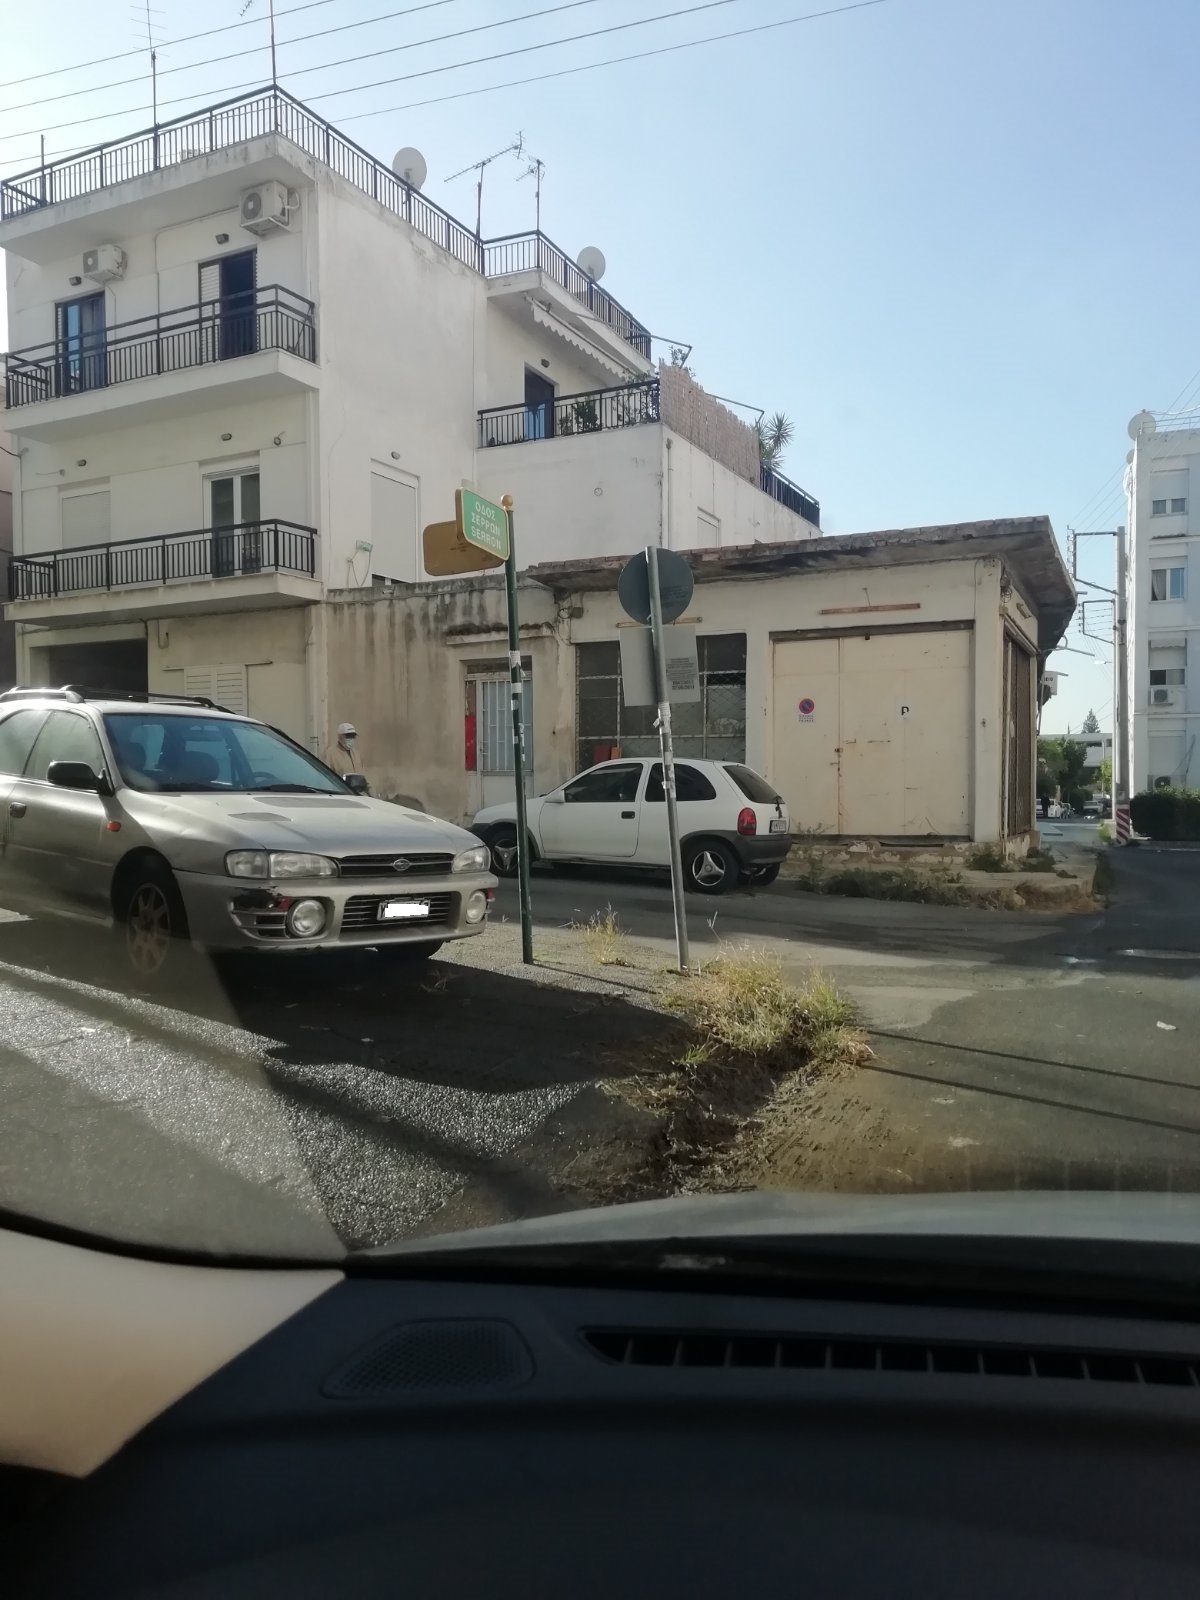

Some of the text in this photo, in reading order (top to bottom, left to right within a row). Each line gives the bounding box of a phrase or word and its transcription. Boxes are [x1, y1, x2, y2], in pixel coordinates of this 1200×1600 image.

[475, 501, 496, 521] ΟΔΟΣ
[471, 512, 501, 536] ΣΕΡΡΩΝ
[471, 525, 502, 551] SERRON
